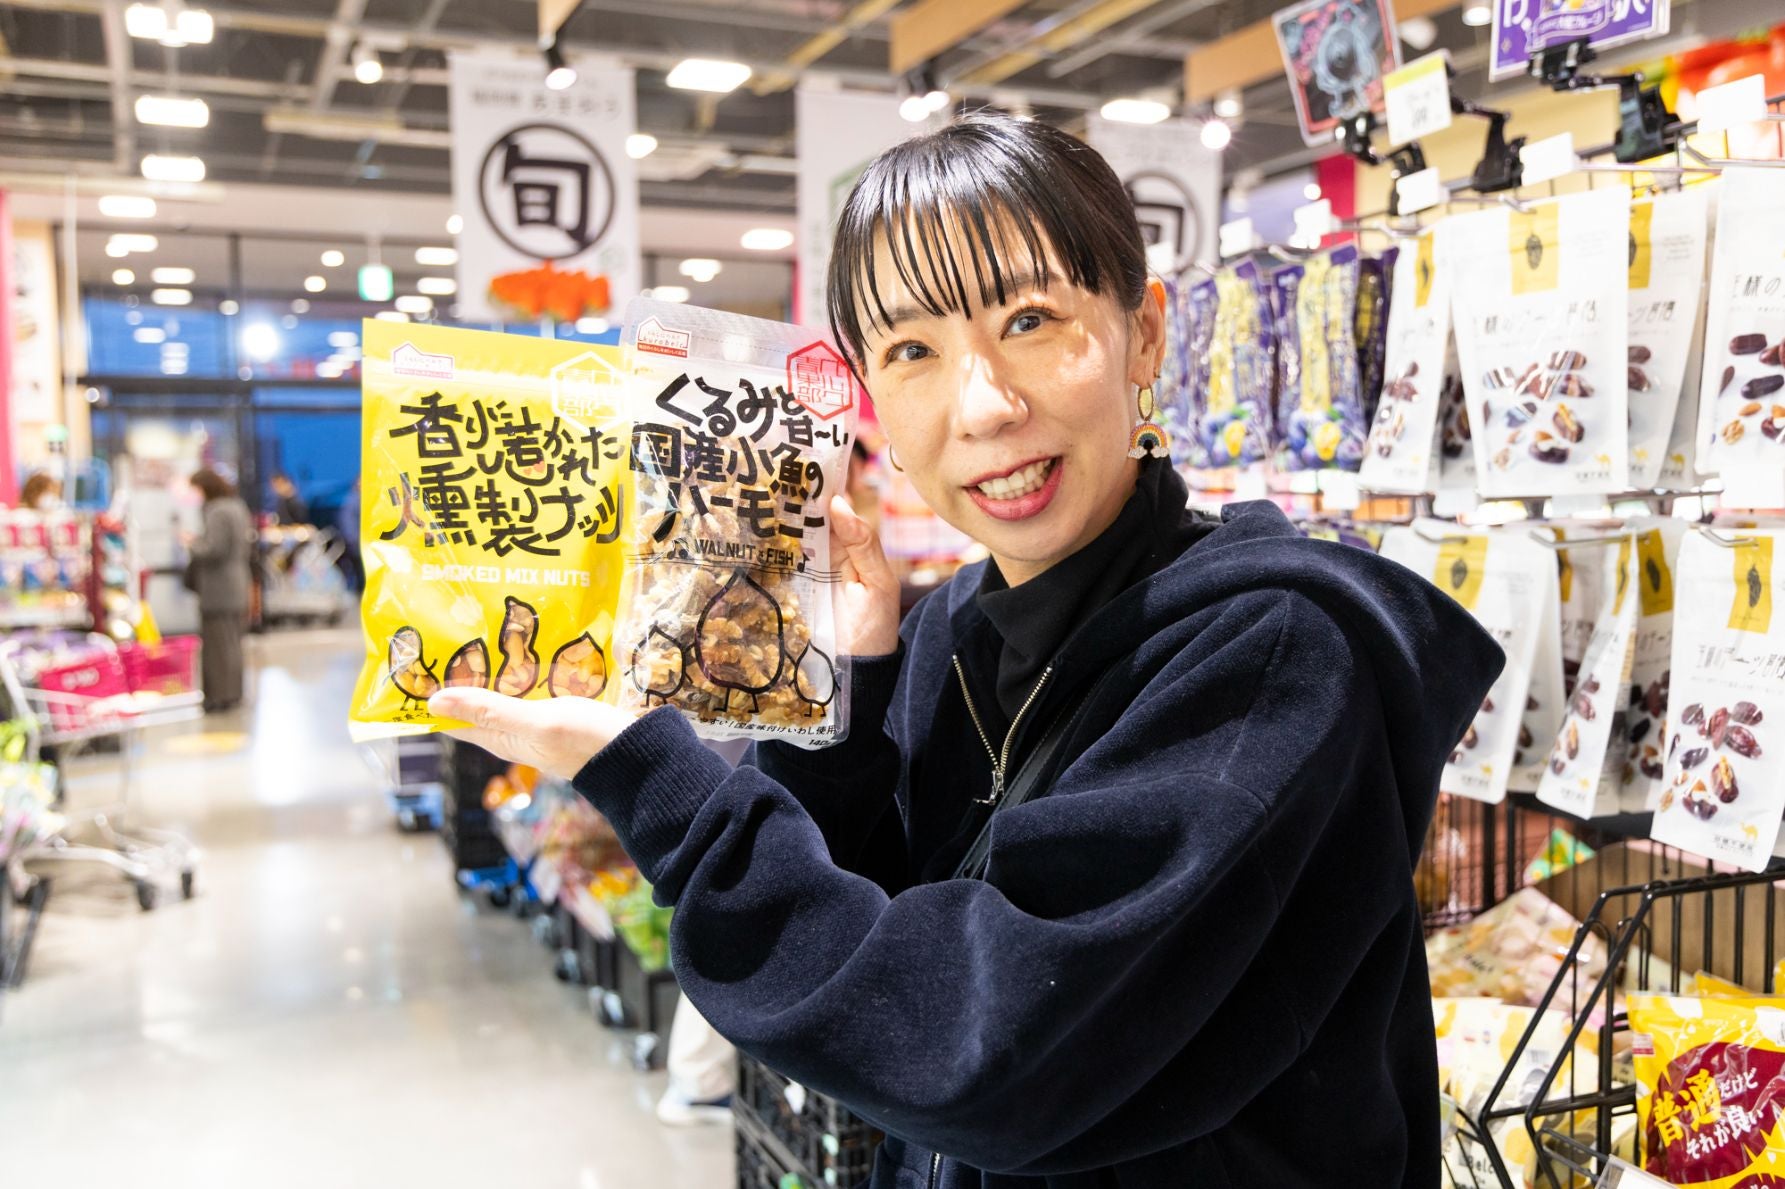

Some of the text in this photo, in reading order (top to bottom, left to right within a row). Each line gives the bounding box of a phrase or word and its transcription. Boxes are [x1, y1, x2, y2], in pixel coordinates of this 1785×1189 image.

[502, 138, 590, 249] 旬
[629, 422, 824, 501] 国産小魚の
[380, 461, 623, 557] 燻製ナッツ
[652, 482, 825, 544] ハーモニー
[421, 563, 590, 588] SMOKED MIX NUTS
[695, 539, 756, 559] WALNUT
[766, 547, 794, 566] FISH
[1653, 1067, 1758, 1148] 普通だけど
[1686, 1104, 1764, 1160] それが良い
